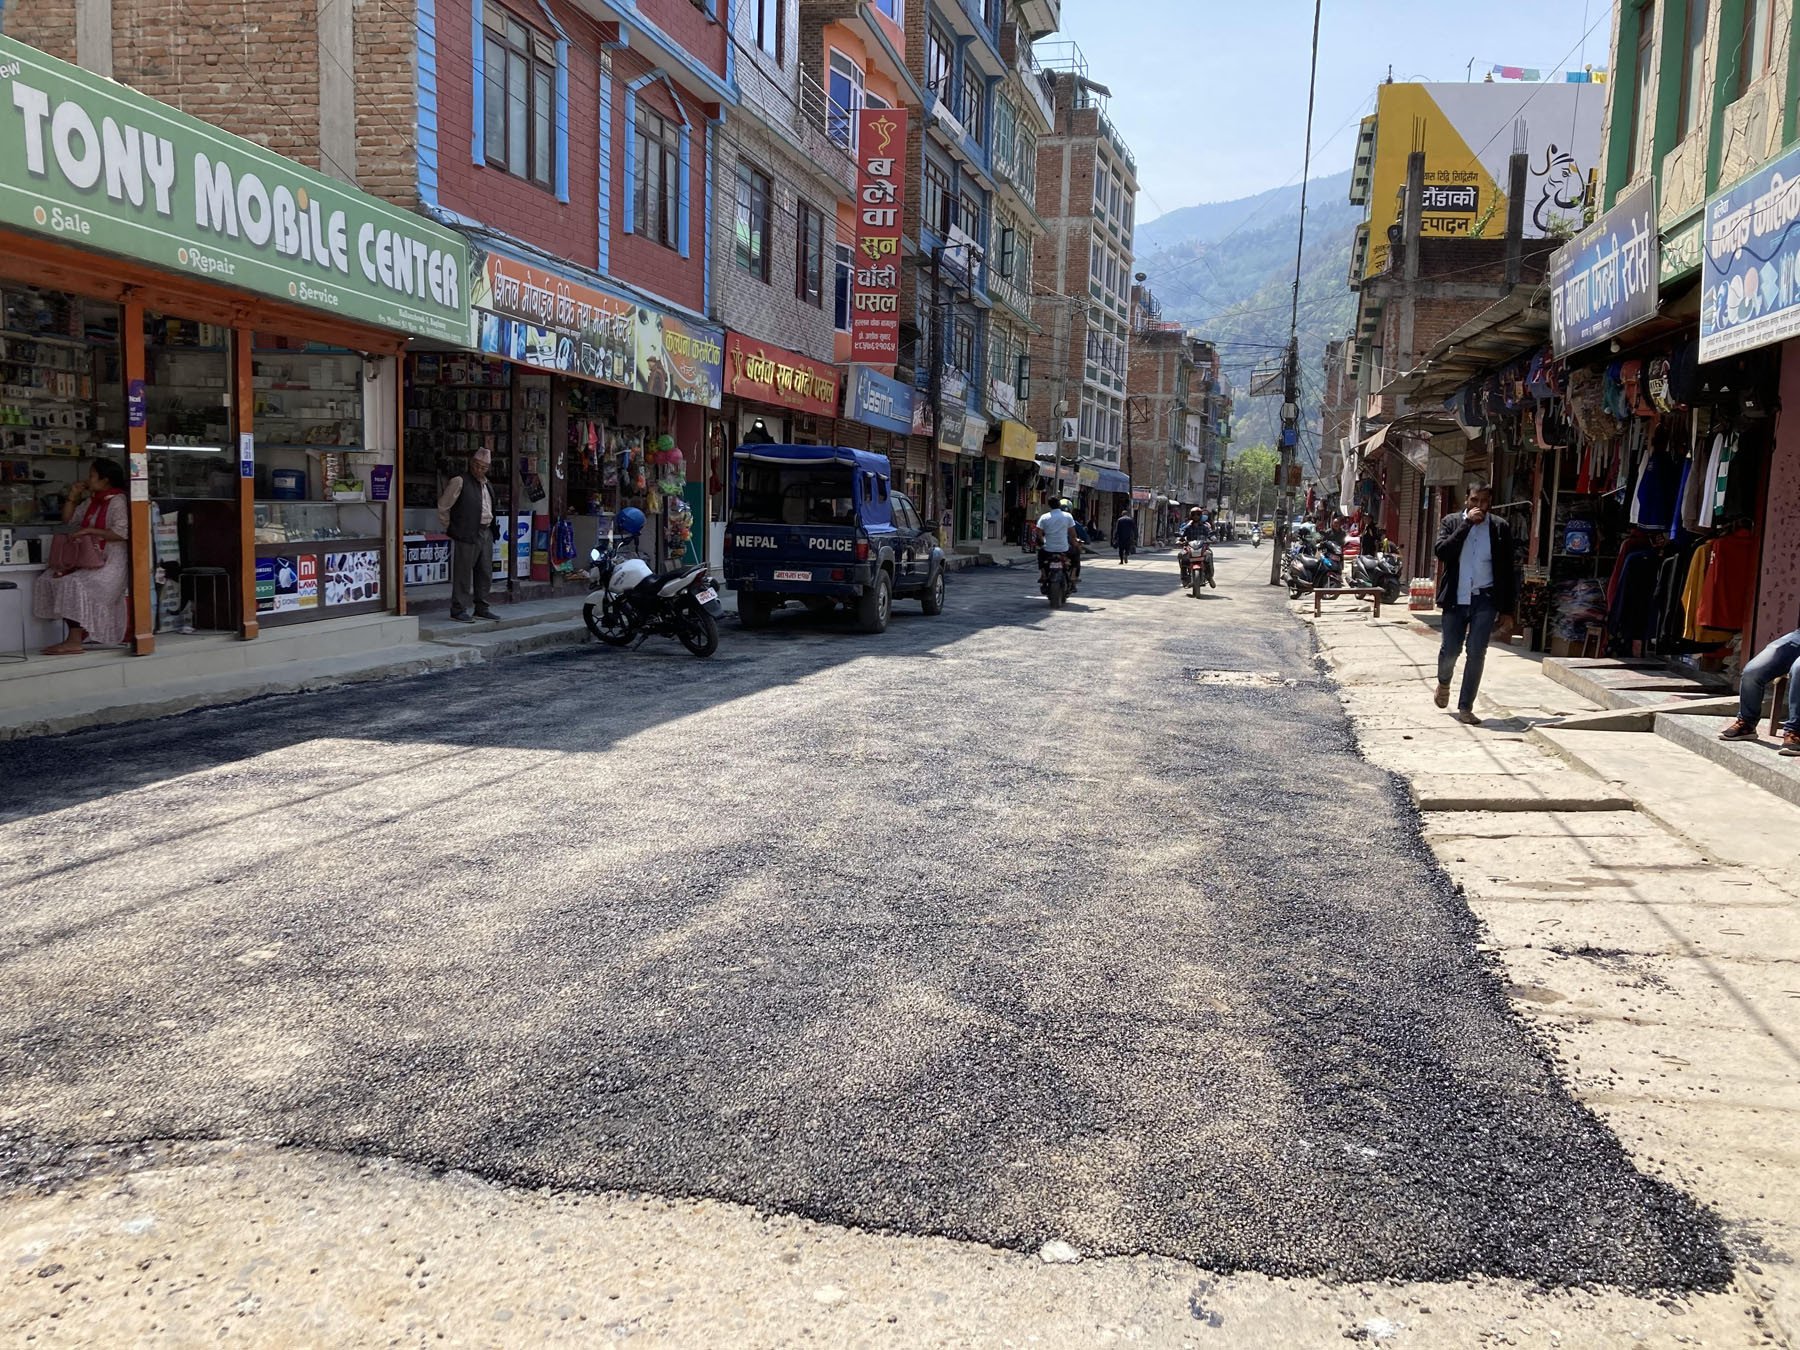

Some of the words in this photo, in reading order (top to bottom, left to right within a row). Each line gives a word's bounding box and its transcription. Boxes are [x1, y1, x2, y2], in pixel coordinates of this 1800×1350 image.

[0, 61, 21, 80] ew
[12, 80, 175, 214] TONY
[358, 222, 459, 310] CENTER
[51, 207, 90, 235] Sale
[860, 237, 898, 260] सुन
[190, 248, 235, 276] Repair
[299, 282, 339, 306] Service
[855, 292, 897, 313] पसल
[776, 363, 795, 396] सुन
[814, 376, 836, 404] पसल
[735, 535, 778, 549] NEPAL
[808, 537, 853, 552] POLICE
